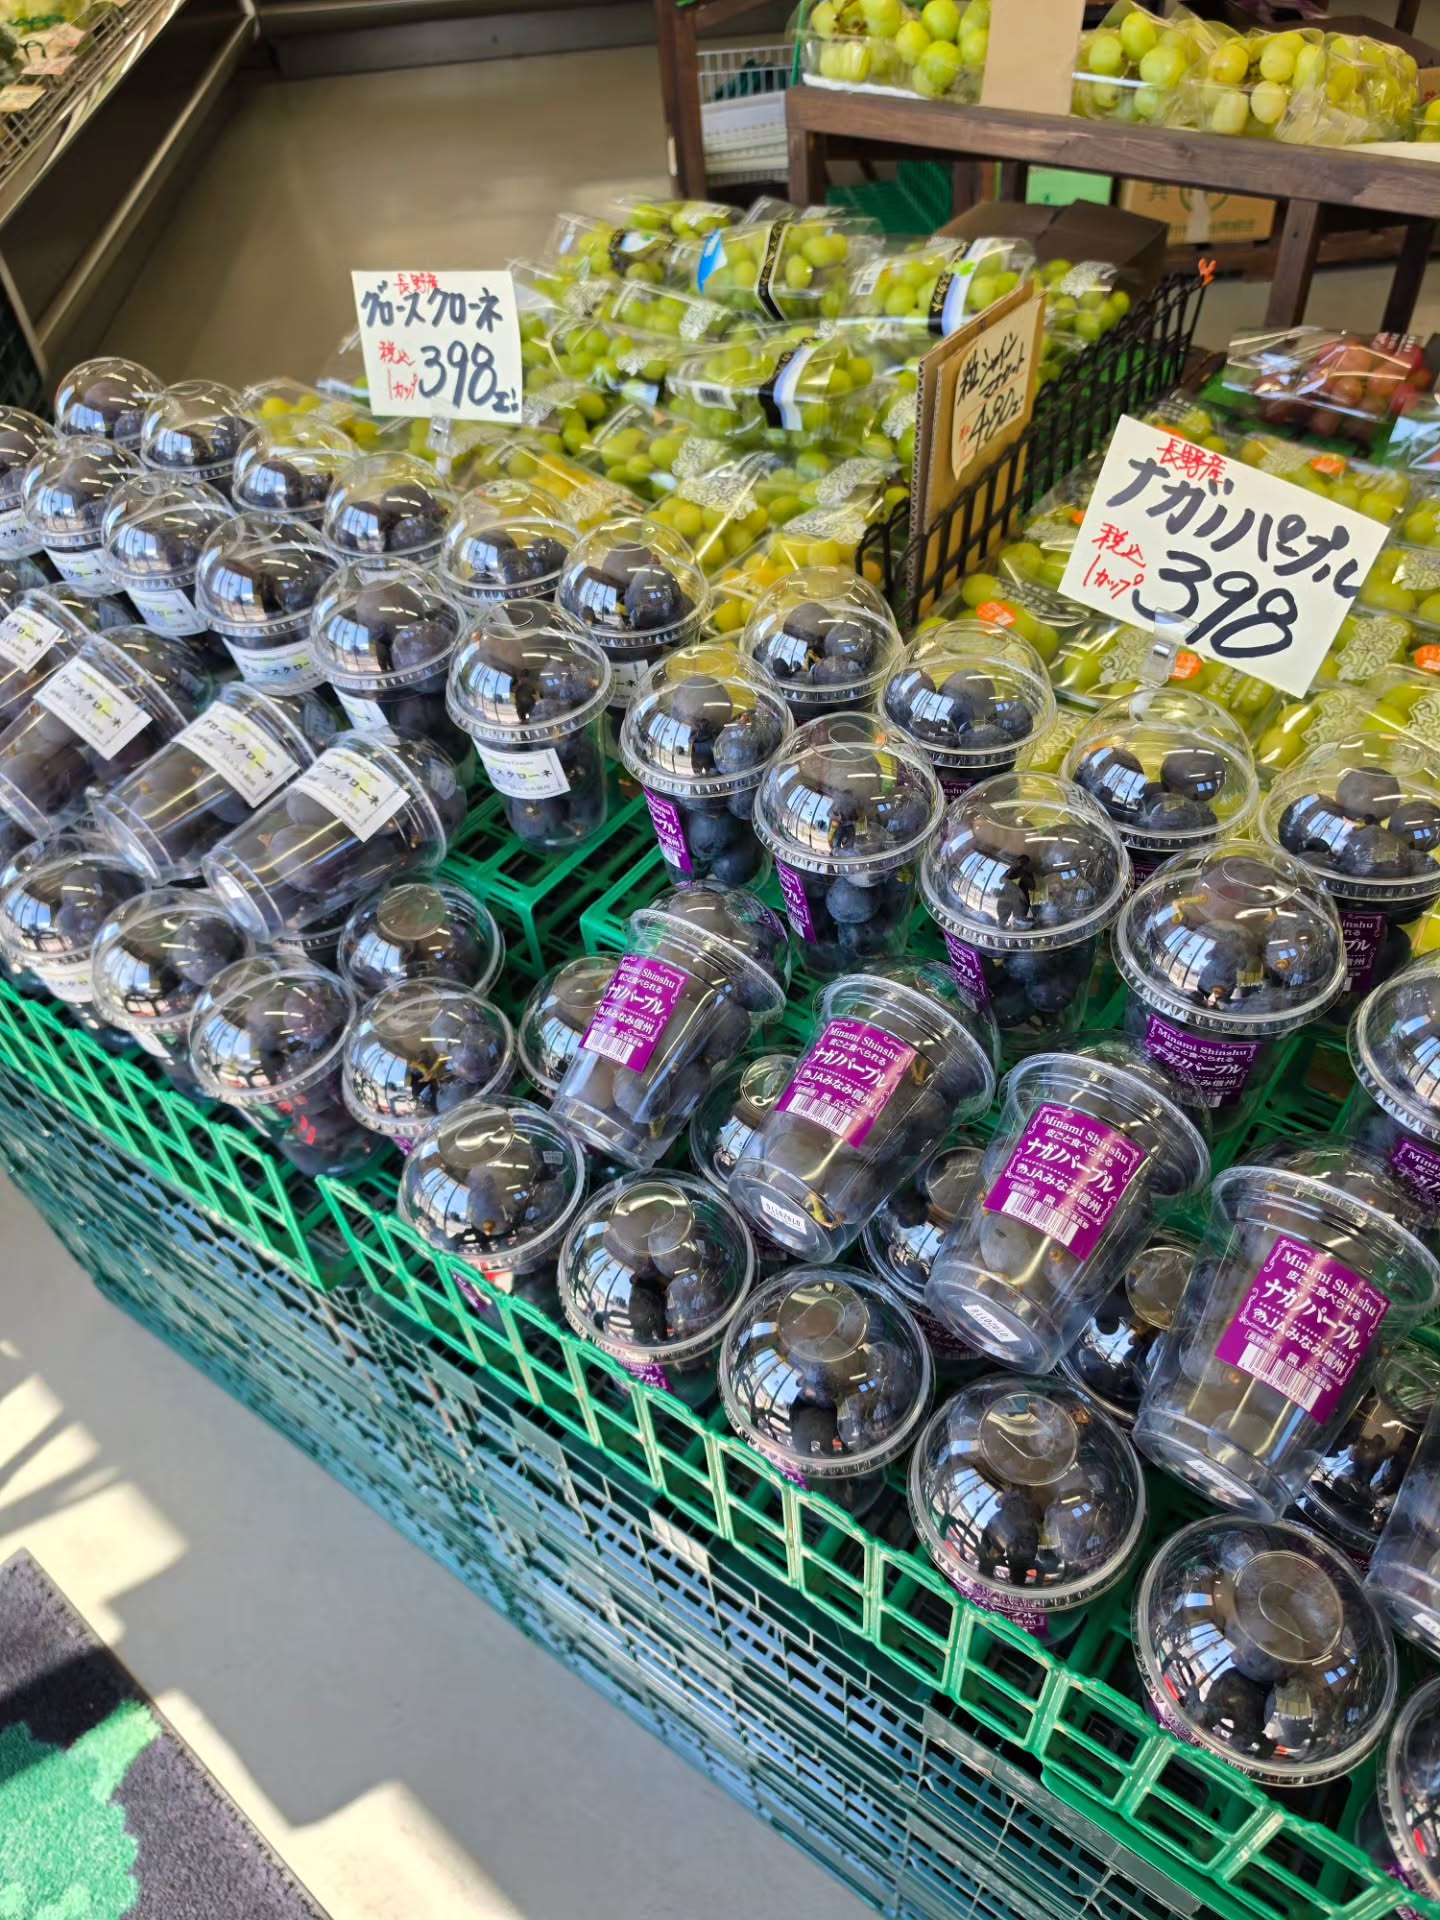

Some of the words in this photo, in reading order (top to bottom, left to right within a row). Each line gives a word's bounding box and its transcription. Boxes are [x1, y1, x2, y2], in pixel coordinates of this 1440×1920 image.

[361, 280, 504, 333] グロースクローネ
[379, 341, 416, 366] 税込
[1157, 438, 1228, 484] 長野産
[1092, 522, 1147, 568] 税込
[1132, 550, 1298, 658] 398
[1343, 920, 1373, 929] inshu
[641, 967, 676, 988] Shinshu
[829, 1027, 861, 1042] Minami
[861, 1036, 901, 1063] Shinshu
[1158, 1027, 1197, 1051] Minami
[1199, 1046, 1247, 1057] Shinshu
[811, 1047, 889, 1088] ナガノパープル
[1042, 1114, 1085, 1137] Minami
[1085, 1131, 1129, 1164] Shinshu
[1045, 1128, 1113, 1167] 皮ごと食べられる
[1024, 1137, 1116, 1193] ナガノパープル
[1026, 1167, 1102, 1215] JAみなみ信州
[1281, 1250, 1333, 1286] Minami
[1332, 1278, 1377, 1317] Shinshu
[1286, 1270, 1362, 1321] 皮ごと食べられる
[1261, 1278, 1360, 1350] ナガノパープル
[1266, 1316, 1347, 1375] JAみなみ信州
